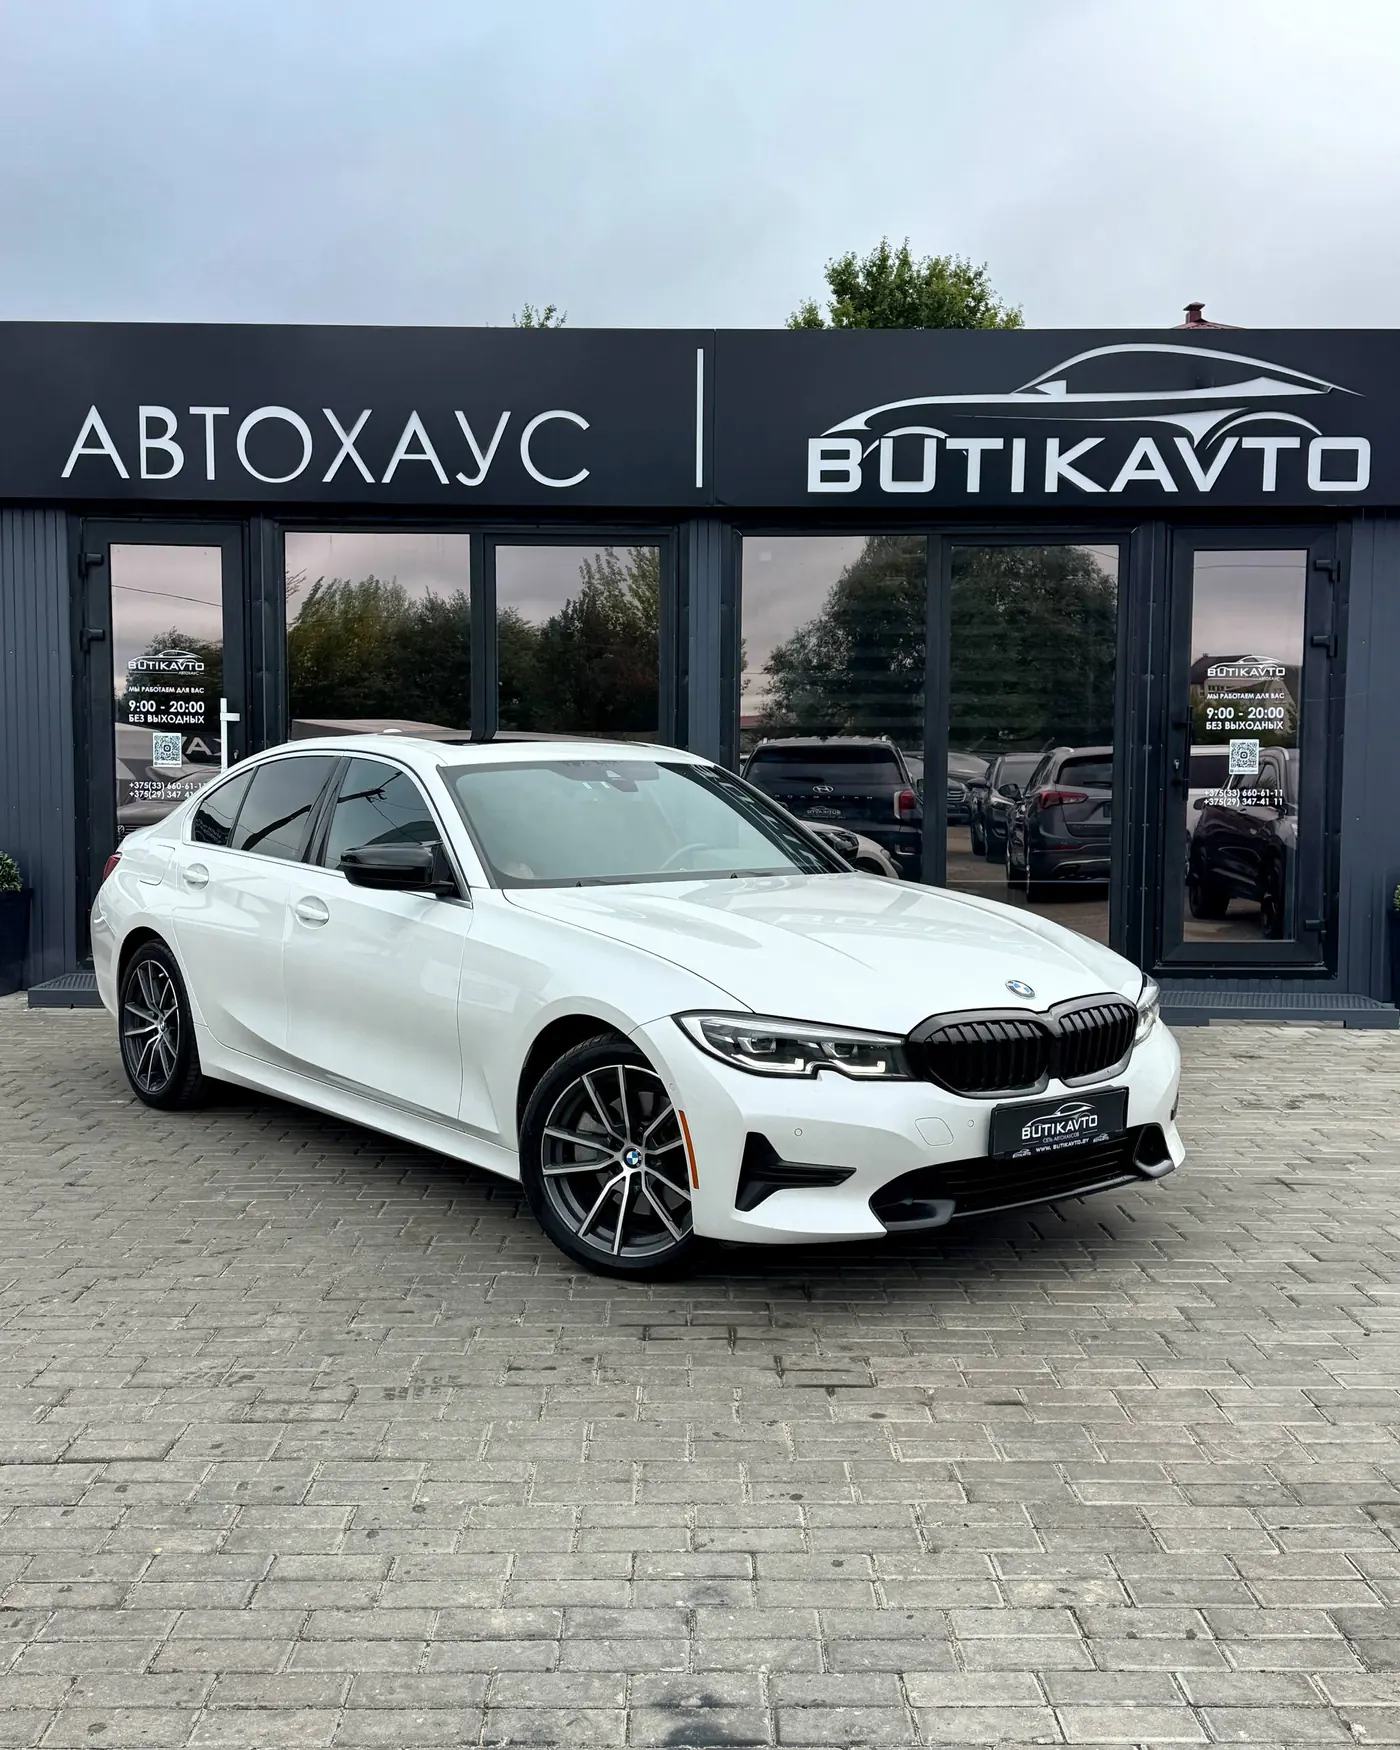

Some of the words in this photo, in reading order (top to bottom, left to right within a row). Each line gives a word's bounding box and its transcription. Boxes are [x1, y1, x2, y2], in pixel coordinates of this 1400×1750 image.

[61, 405, 590, 487] АВТОХАУС
[808, 437, 1370, 492] BUTIKAVTO
[128, 661, 205, 671] BUTIKAVTO
[1207, 667, 1286, 677] BUTIKAVTO
[1255, 692, 1270, 700] ДЛЯ
[128, 700, 157, 712] 9:00
[169, 701, 205, 713] 20:00
[1206, 707, 1235, 719] 9:00
[1248, 707, 1285, 719] 20:00
[128, 714, 145, 723] БЕЗ
[147, 714, 205, 725] ВЫХОДНЫХ
[1206, 721, 1223, 730] БЕЗ
[1225, 720, 1284, 731] ВЫХОДНЫХ
[1204, 788, 1241, 799] +375(33)
[1242, 789, 1283, 798] 660-61-11
[1204, 798, 1241, 807] +375(29)
[1021, 1115, 1098, 1140] BUTIKAVTO
